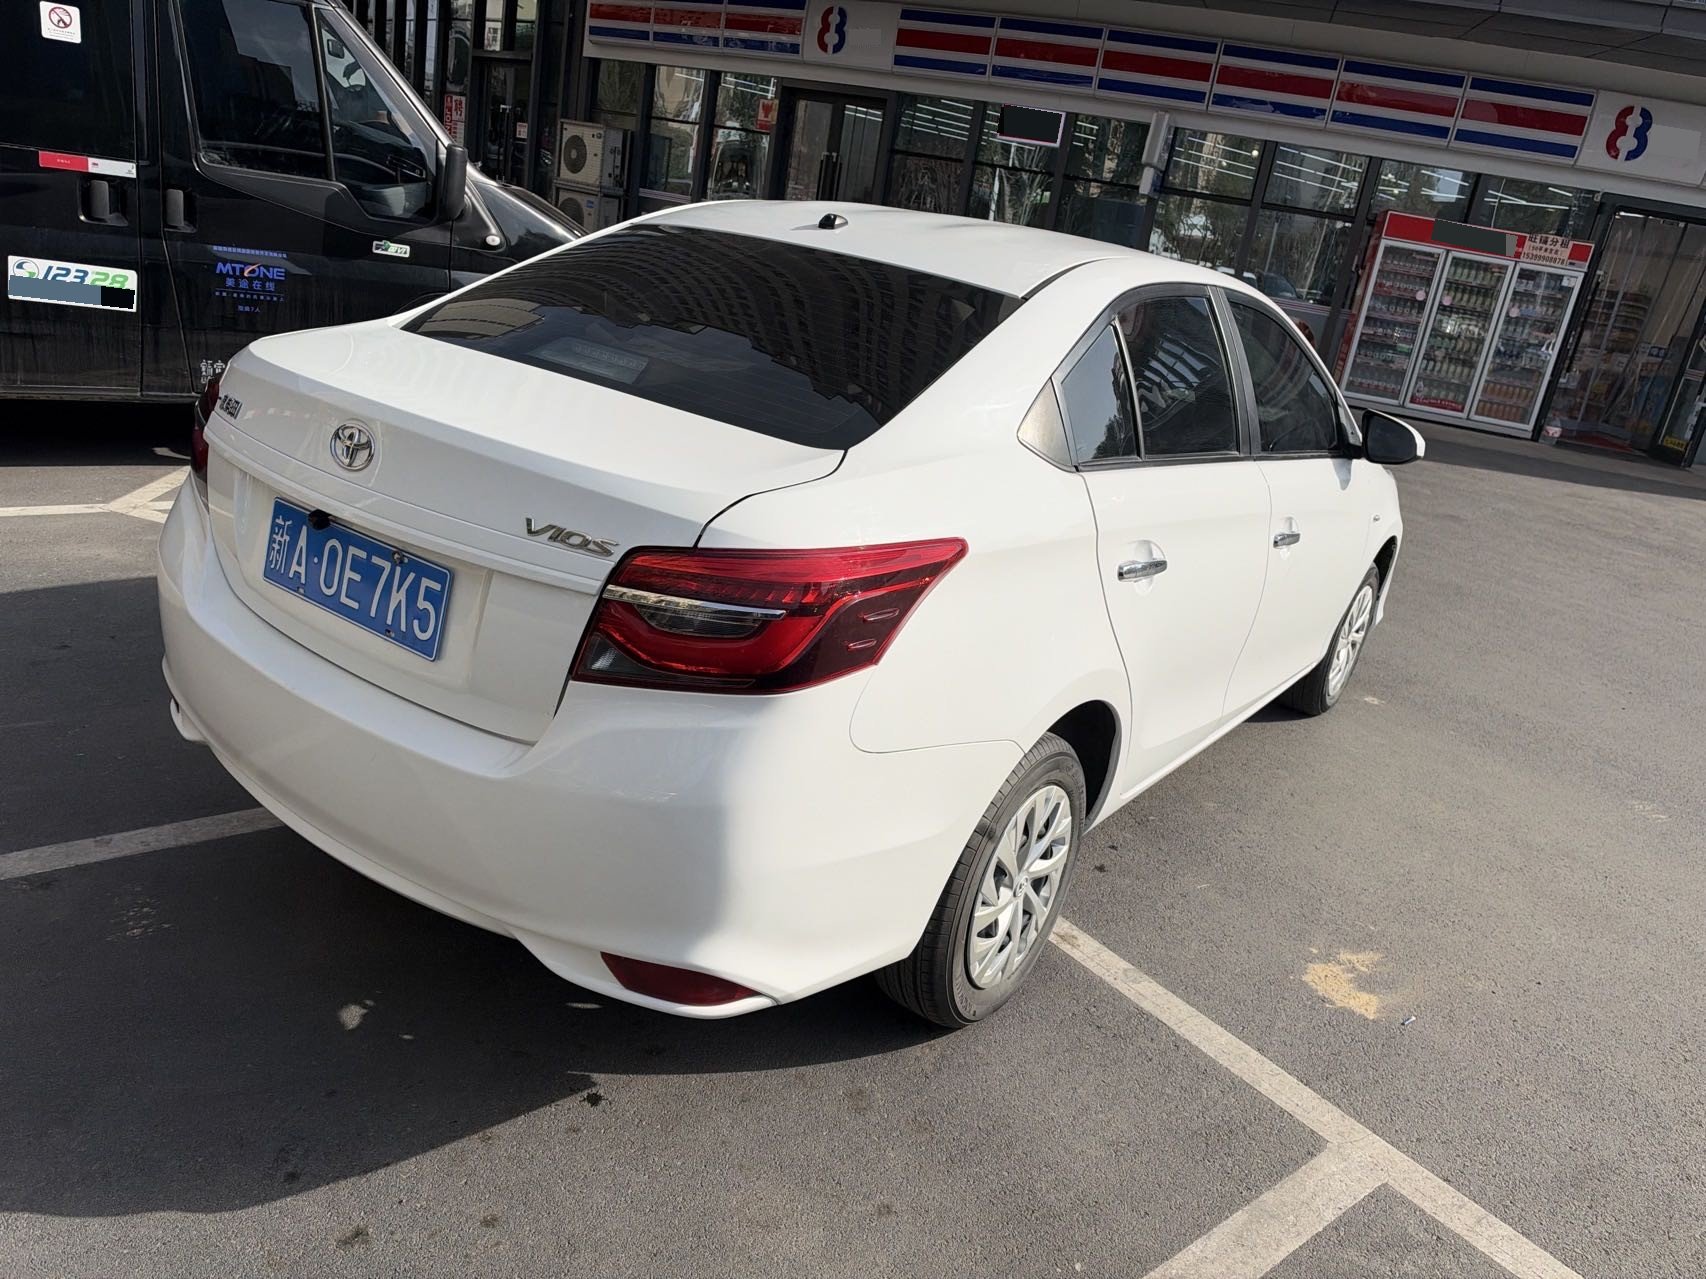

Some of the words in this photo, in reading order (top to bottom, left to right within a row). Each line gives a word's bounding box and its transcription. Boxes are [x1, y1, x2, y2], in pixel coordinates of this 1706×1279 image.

[216, 262, 286, 280] MTONE
[225, 277, 275, 292] 美途在线
[525, 517, 620, 558] VIOS
